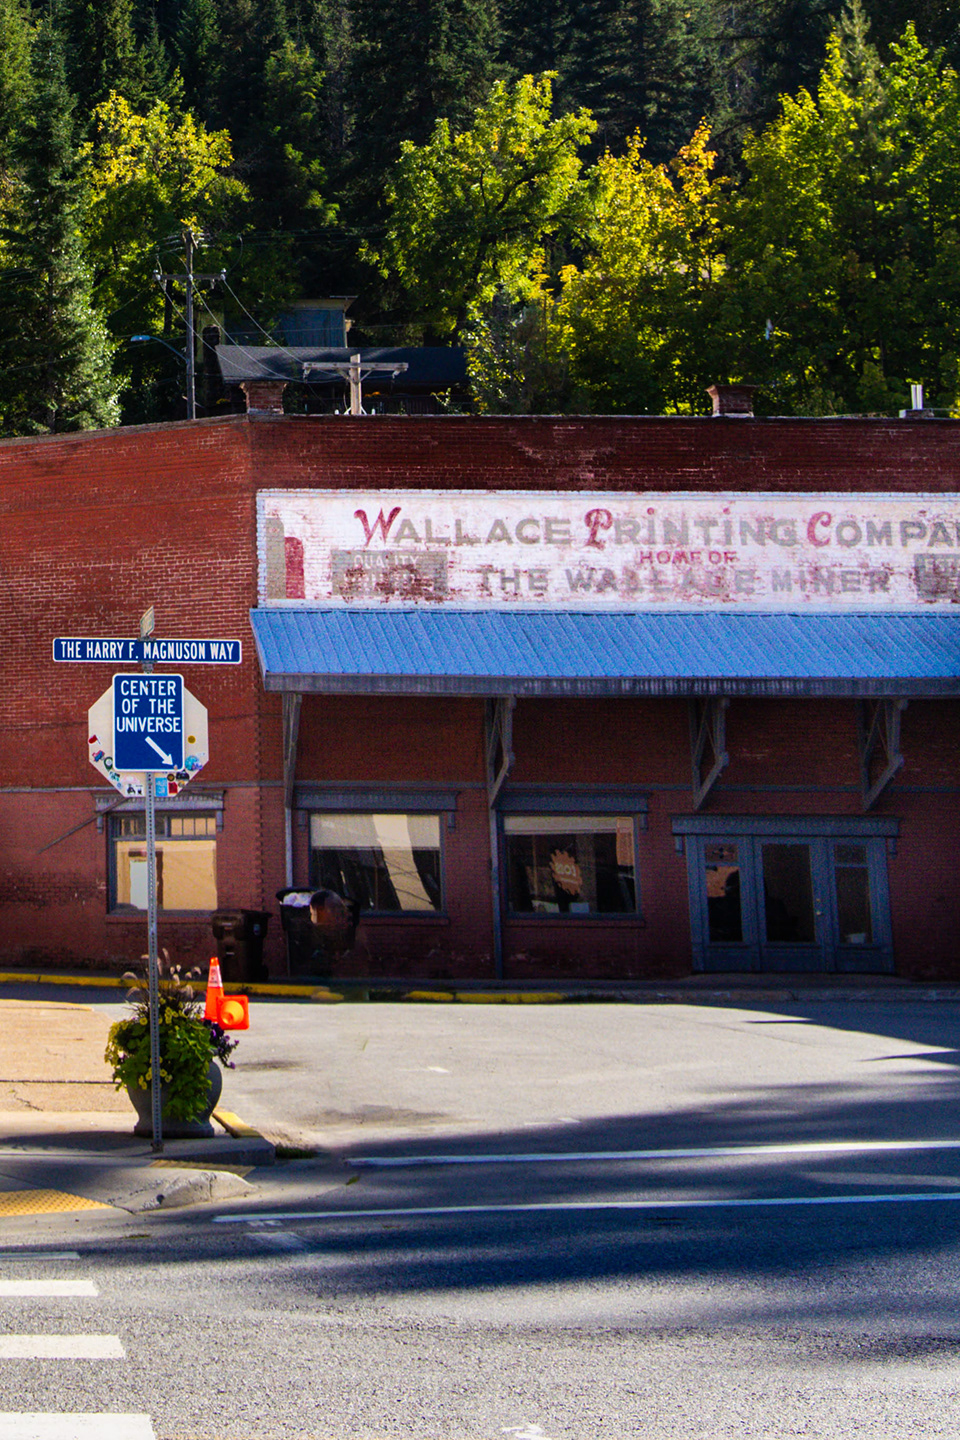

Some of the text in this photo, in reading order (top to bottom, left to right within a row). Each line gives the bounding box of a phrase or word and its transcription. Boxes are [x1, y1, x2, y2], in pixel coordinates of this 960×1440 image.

[353, 506, 571, 547] WALLACE
[806, 510, 960, 547] COMPA
[354, 554, 420, 570] QUAITY
[640, 550, 738, 565] HOME OF
[479, 567, 549, 592] THE
[771, 568, 891, 593] MINER
[60, 641, 234, 660] THE HARRY F. MAGNUSON WAY
[120, 680, 177, 696] CENTER
[121, 698, 176, 715] OF THE
[116, 716, 182, 733] UNIVERSE
